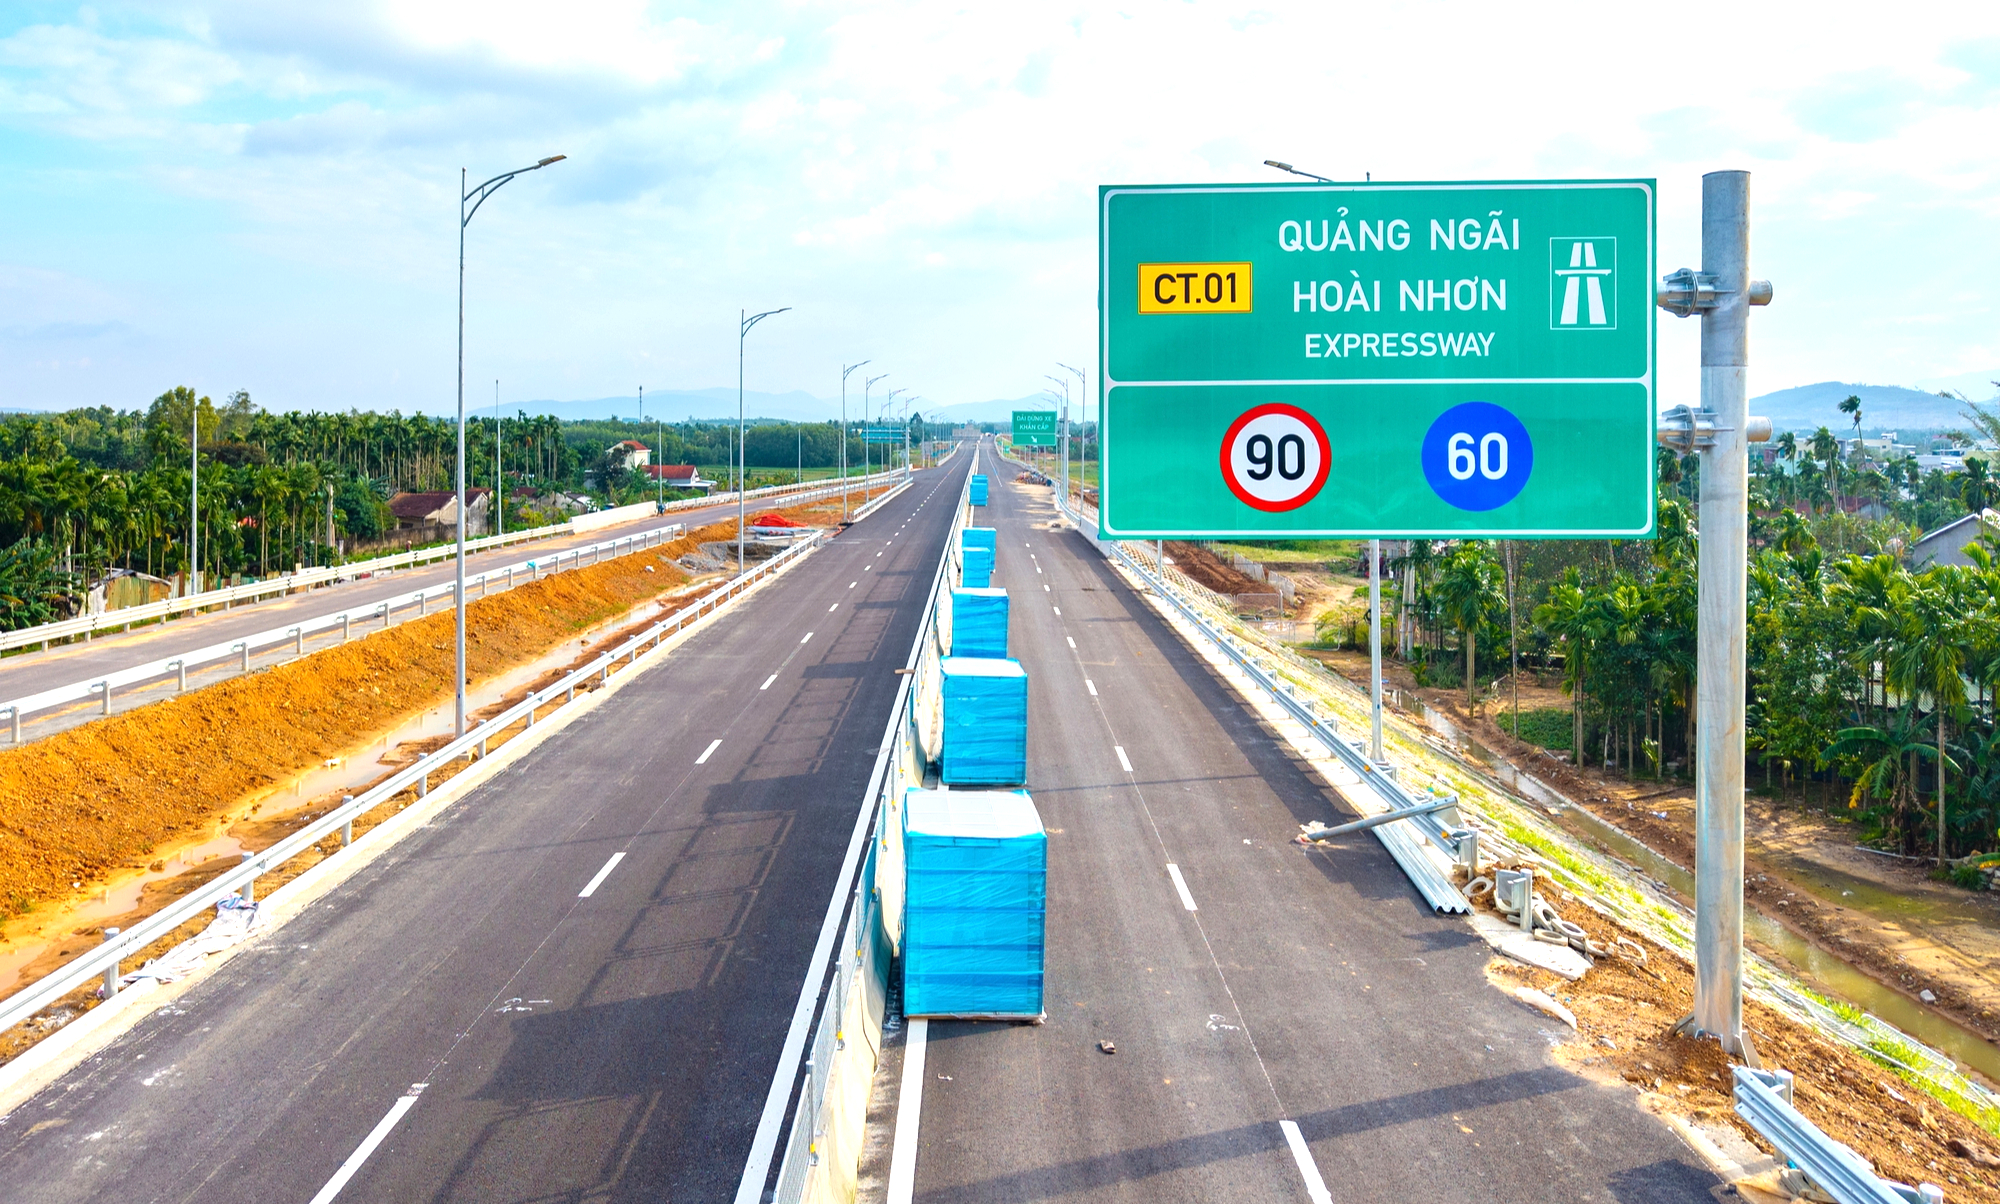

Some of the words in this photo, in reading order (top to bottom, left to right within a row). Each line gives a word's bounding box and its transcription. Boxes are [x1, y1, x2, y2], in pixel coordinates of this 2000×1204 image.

[1278, 206, 1411, 253] QUẢNG
[1429, 209, 1520, 252] NGÃI
[1153, 271, 1238, 305] CT.01
[1293, 269, 1381, 313] HOÀI
[1399, 275, 1507, 312] NHƠN
[1304, 331, 1496, 358] EXPRESSWAY
[1245, 433, 1307, 481] 90
[1447, 432, 1509, 481] 60
